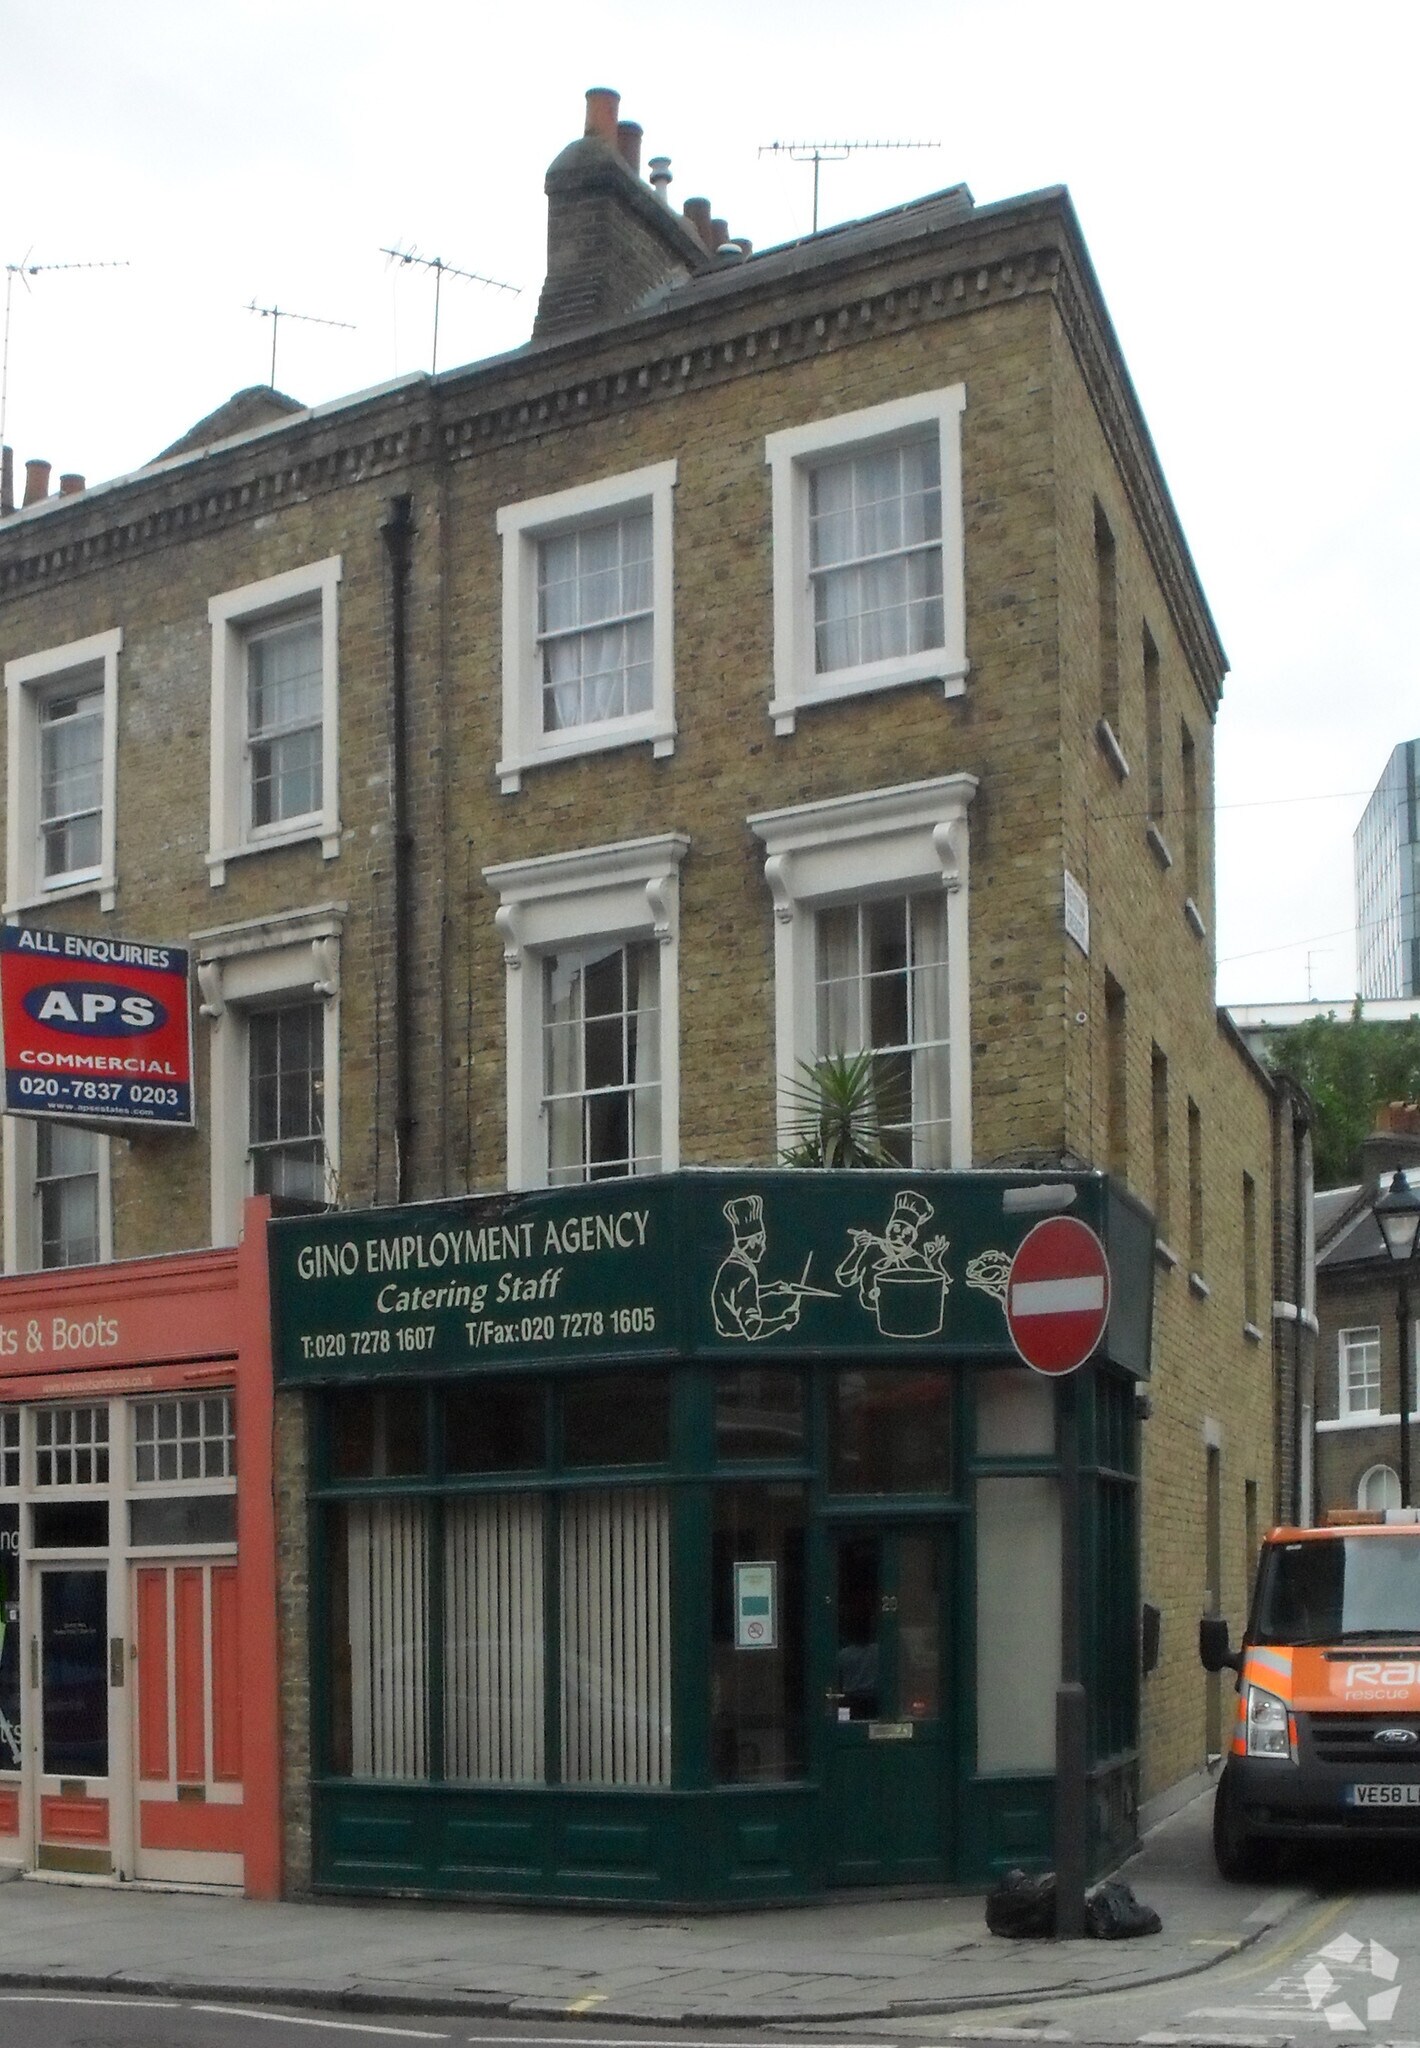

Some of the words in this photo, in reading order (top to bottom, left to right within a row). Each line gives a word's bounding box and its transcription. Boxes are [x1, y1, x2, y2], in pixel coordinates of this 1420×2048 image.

[18, 930, 60, 952] ALL
[64, 937, 170, 968] ENQUIRIES
[38, 990, 155, 1027] APS
[19, 1050, 177, 1075] COMMERCIAL
[47, 1101, 154, 1117] www.apsestates.com
[130, 1085, 179, 1106] 0203
[298, 1241, 359, 1280] GINO
[366, 1222, 536, 1273] EMPLOYMENT
[543, 1209, 650, 1256] AGENCY
[376, 1278, 489, 1315] Catering
[497, 1266, 564, 1303] Staff
[25, 1319, 44, 1354] &
[52, 1315, 119, 1351] Boots
[300, 1334, 346, 1359] T:020
[350, 1330, 391, 1356] 7278
[395, 1325, 437, 1352] 1607
[465, 1315, 555, 1348] T/Fax:020
[560, 1311, 604, 1339] 7278
[611, 1306, 656, 1334] 1605
[1345, 1689, 1409, 1701] rescue
[1357, 1787, 1402, 1803] VE58
[1407, 1787, 1420, 1803] L
